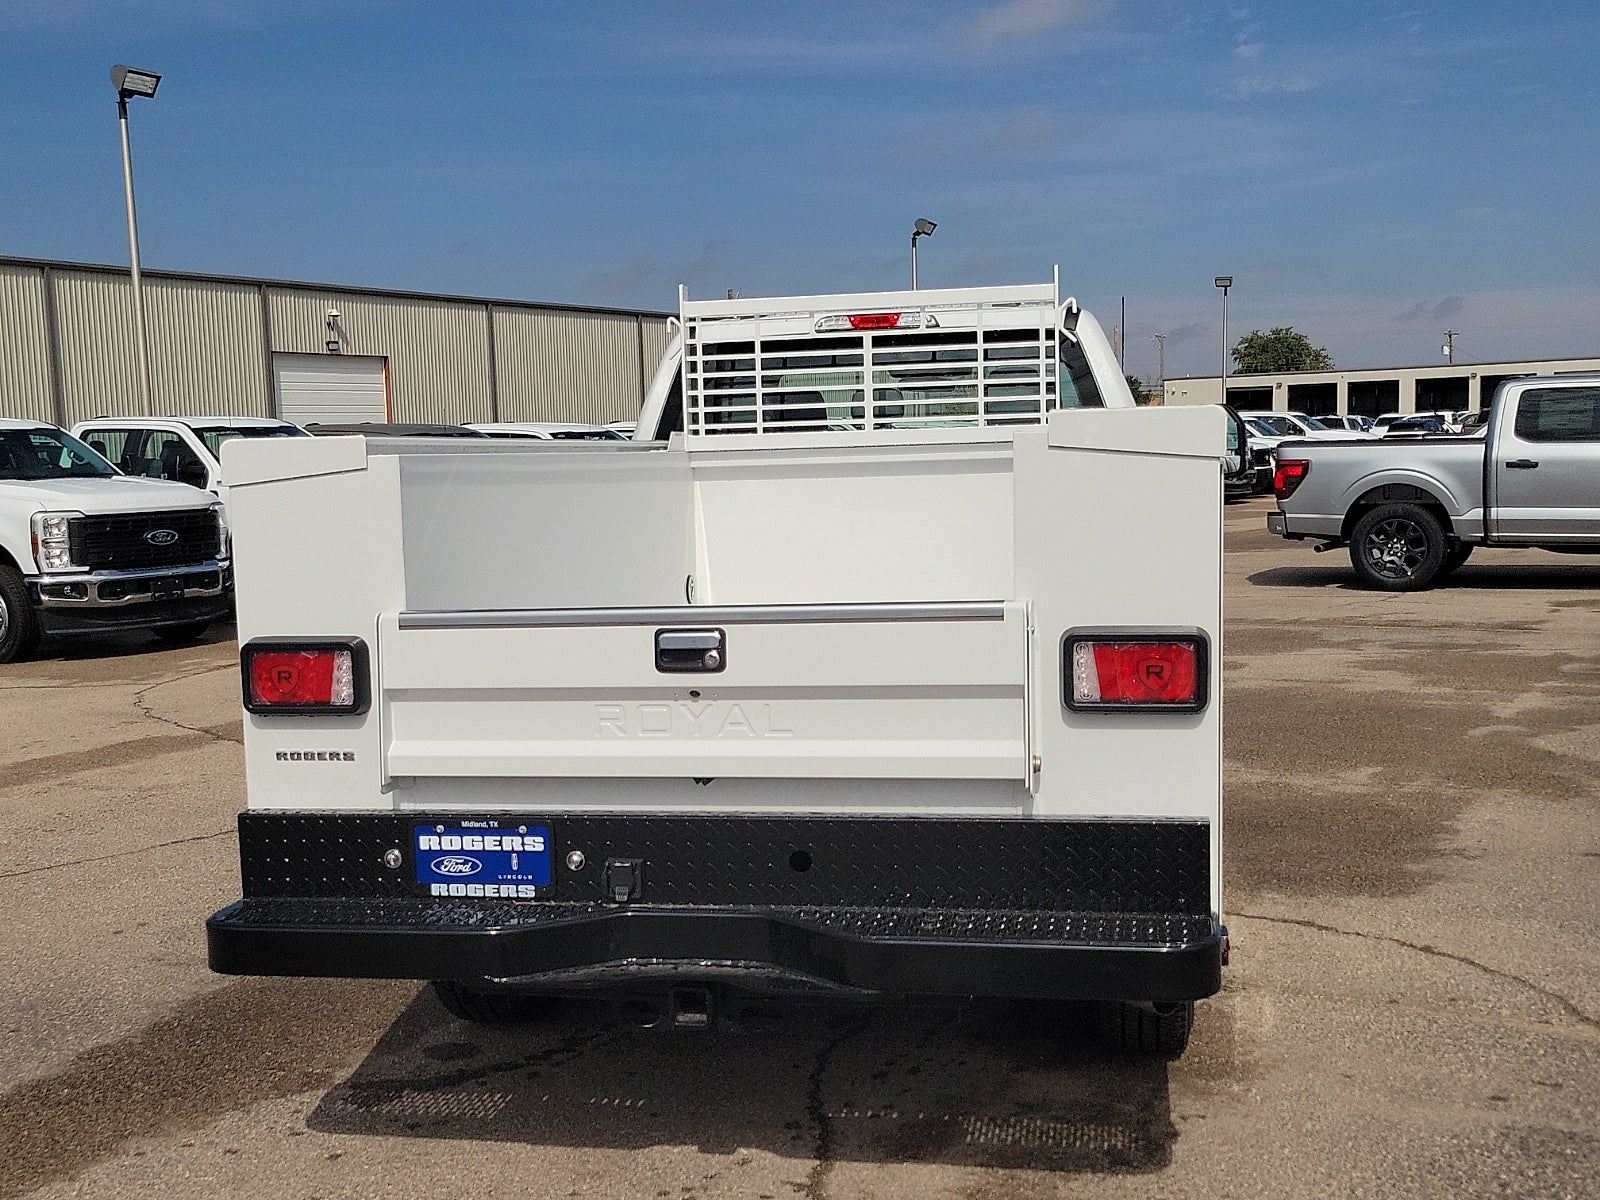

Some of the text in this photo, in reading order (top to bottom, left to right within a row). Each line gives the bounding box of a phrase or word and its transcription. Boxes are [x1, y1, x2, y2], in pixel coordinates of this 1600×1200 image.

[277, 670, 292, 683] R
[1146, 664, 1164, 680] R
[594, 703, 793, 737] ROYAL
[276, 751, 355, 762] ROGERS
[461, 820, 489, 829] Midland,
[419, 835, 545, 852] ROGERS
[440, 858, 473, 873] Ford
[430, 883, 536, 898] ROGERS
